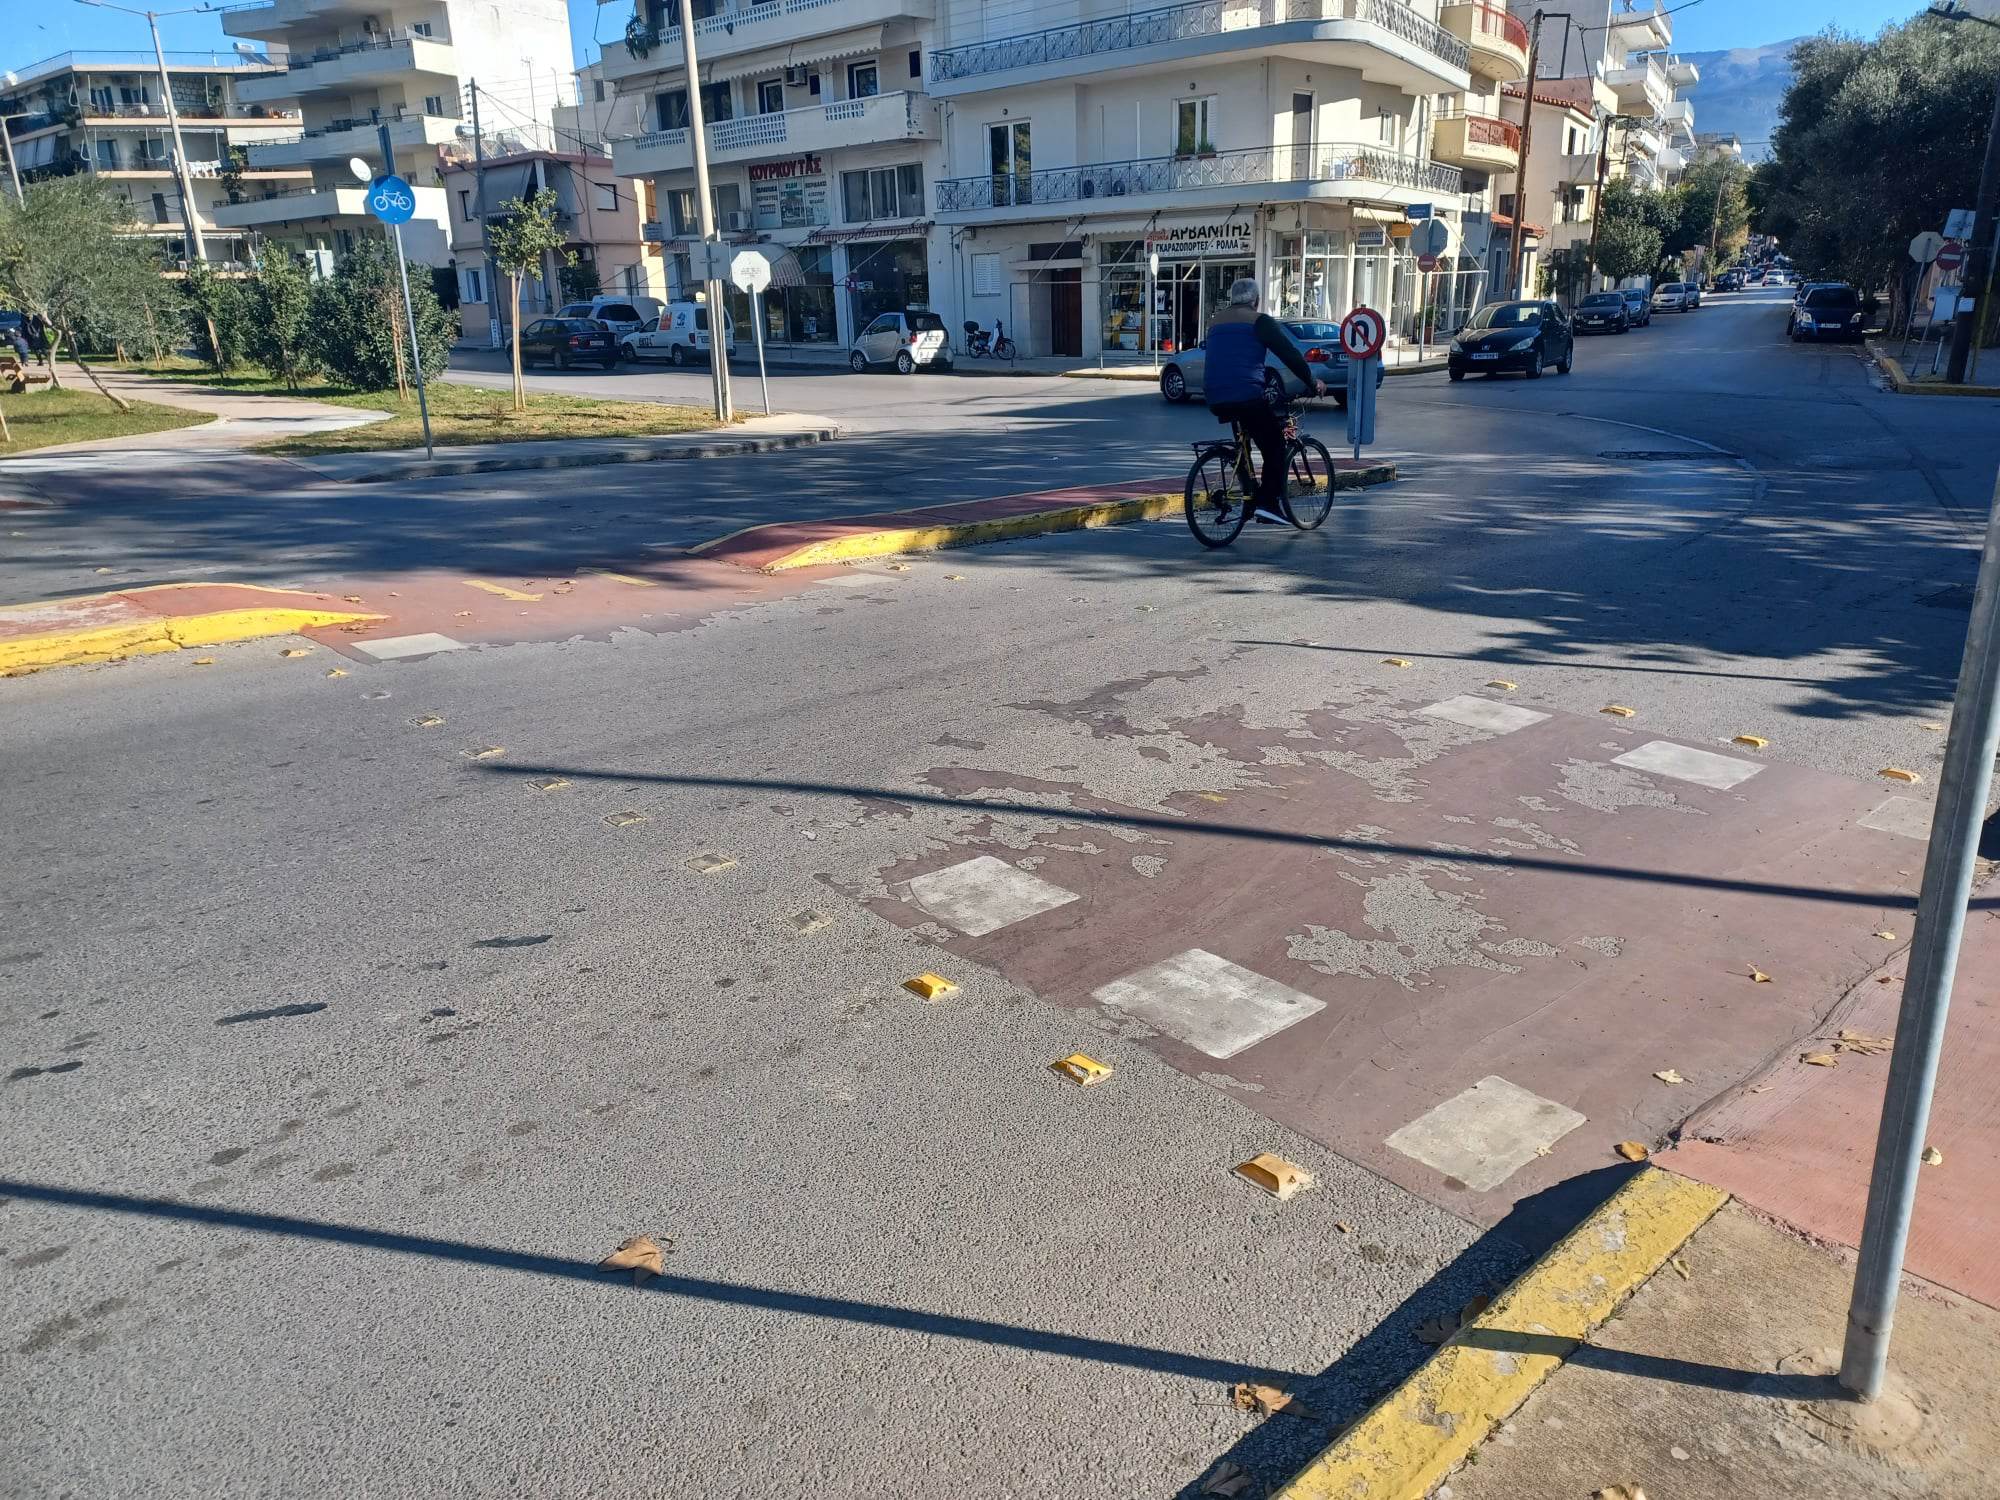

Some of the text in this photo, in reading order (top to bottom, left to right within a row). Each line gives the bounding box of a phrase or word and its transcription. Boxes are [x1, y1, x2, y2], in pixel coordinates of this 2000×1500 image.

[749, 157, 822, 180] ΚΟΥΡΚΟΥΤΑΣ
[1155, 241, 1209, 253] ΓΚΑΡΑΖΟΠΟΡΤΕΣ
[1216, 239, 1239, 250] ΡΟΛΛΑ
